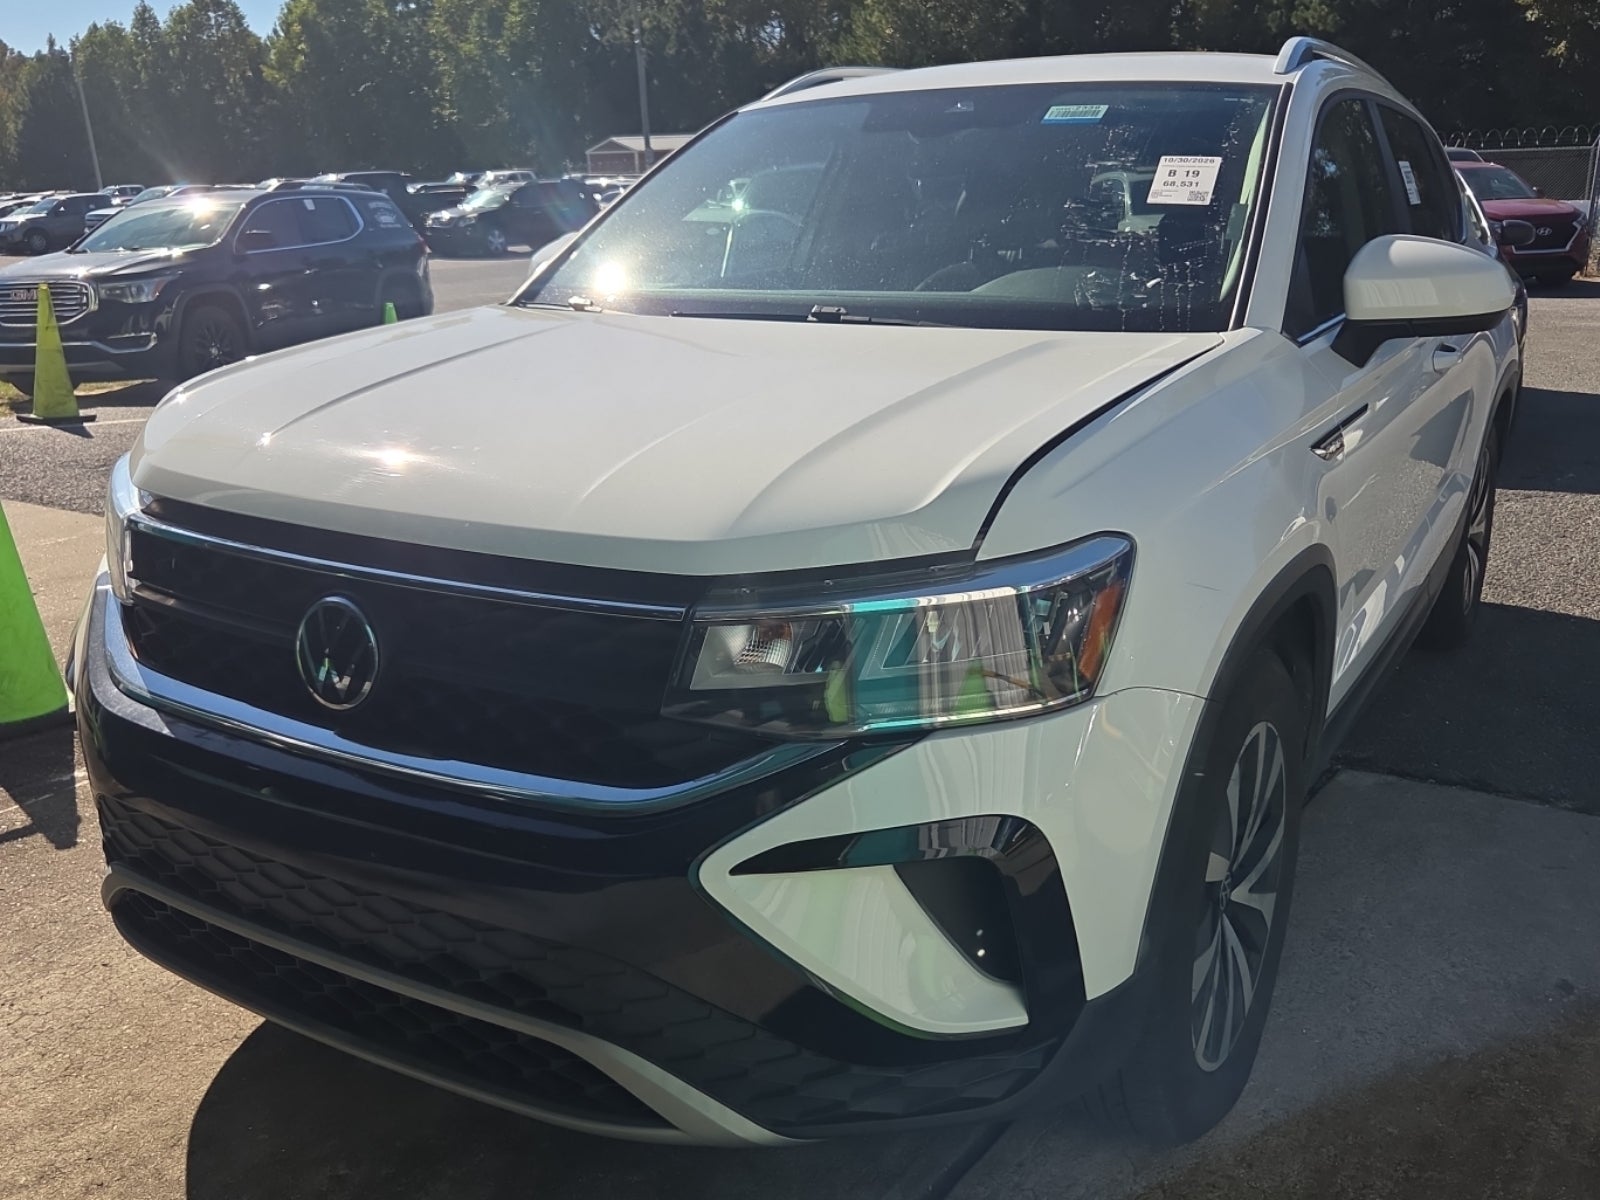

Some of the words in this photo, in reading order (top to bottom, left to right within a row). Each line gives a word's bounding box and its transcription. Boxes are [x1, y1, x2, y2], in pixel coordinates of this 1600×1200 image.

[1168, 169, 1177, 177] B
[1184, 170, 1200, 178] 19
[1163, 180, 1200, 188] 68,531
[10, 289, 40, 301] GM
